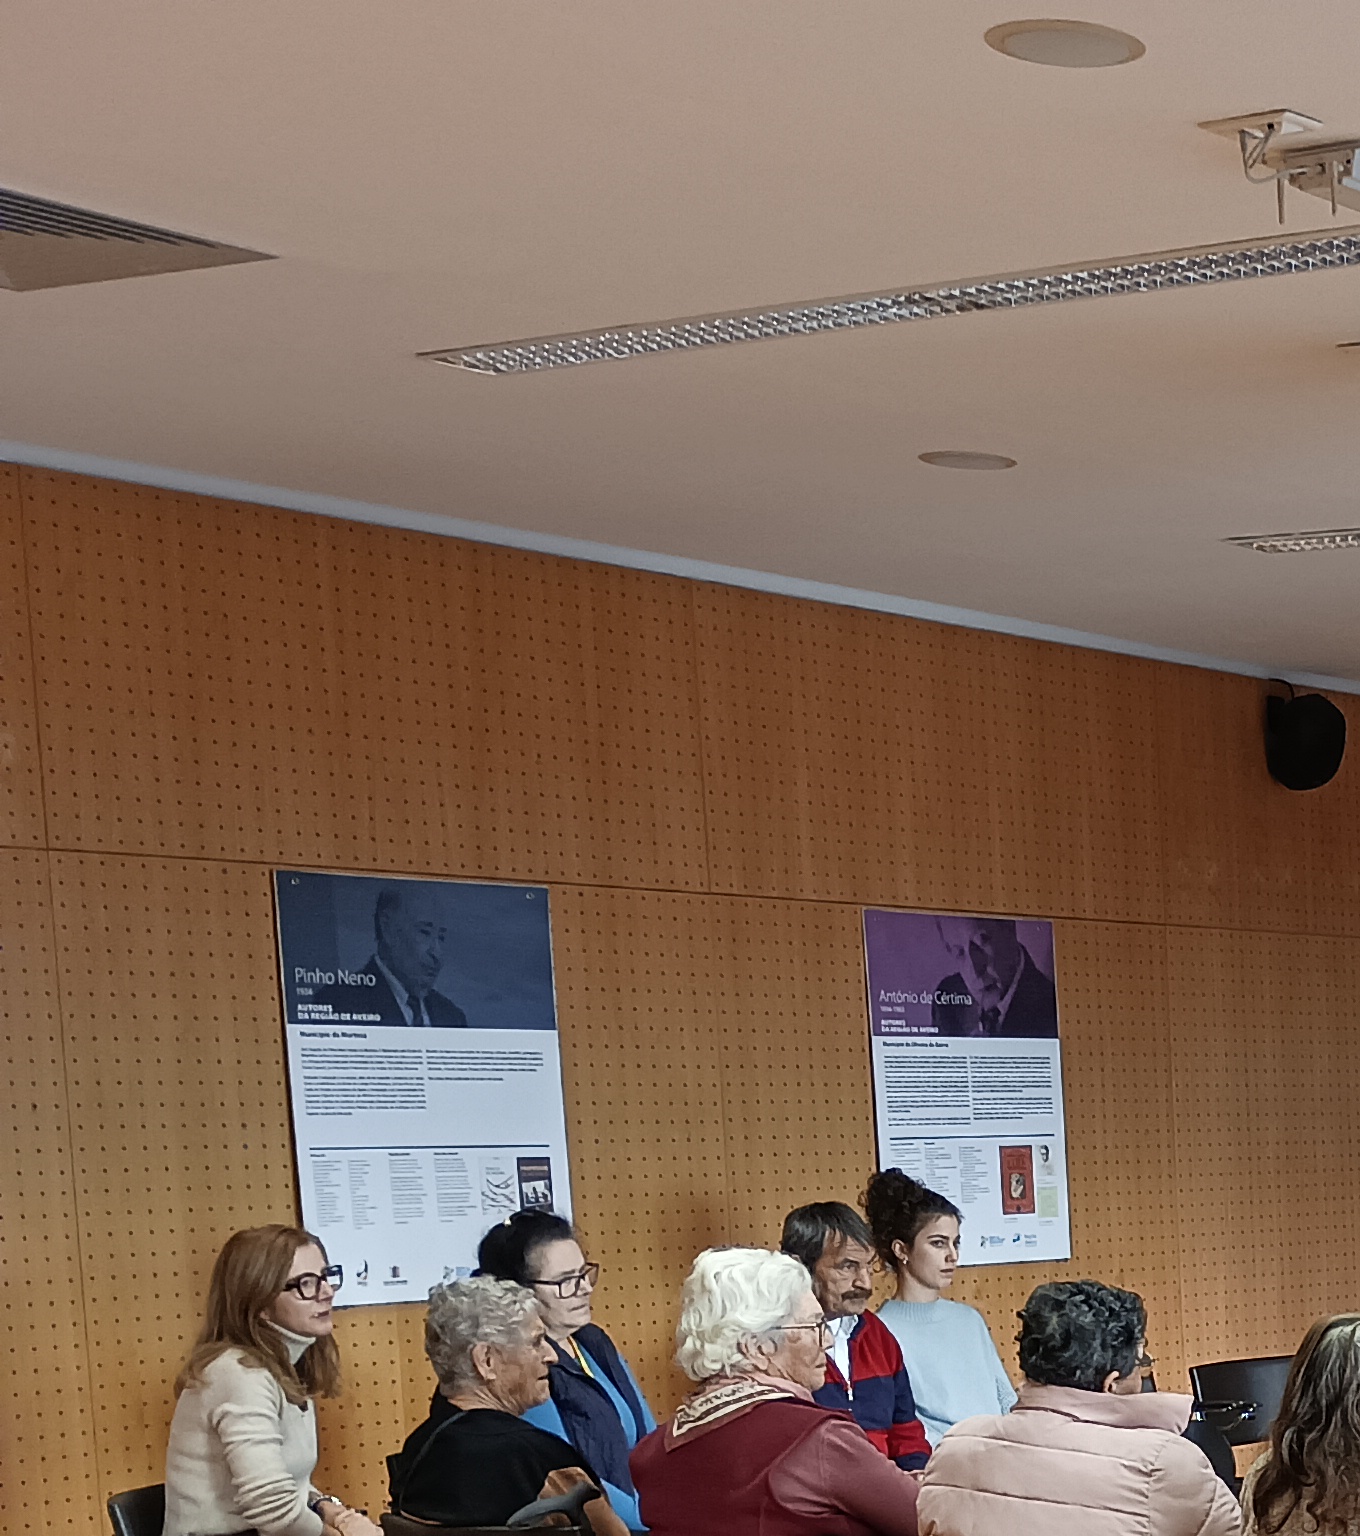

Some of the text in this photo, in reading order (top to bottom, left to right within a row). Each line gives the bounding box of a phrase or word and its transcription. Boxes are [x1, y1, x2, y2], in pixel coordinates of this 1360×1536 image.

[294, 966, 377, 986] Pinho Neno
[879, 989, 973, 1005] António de Cértima
